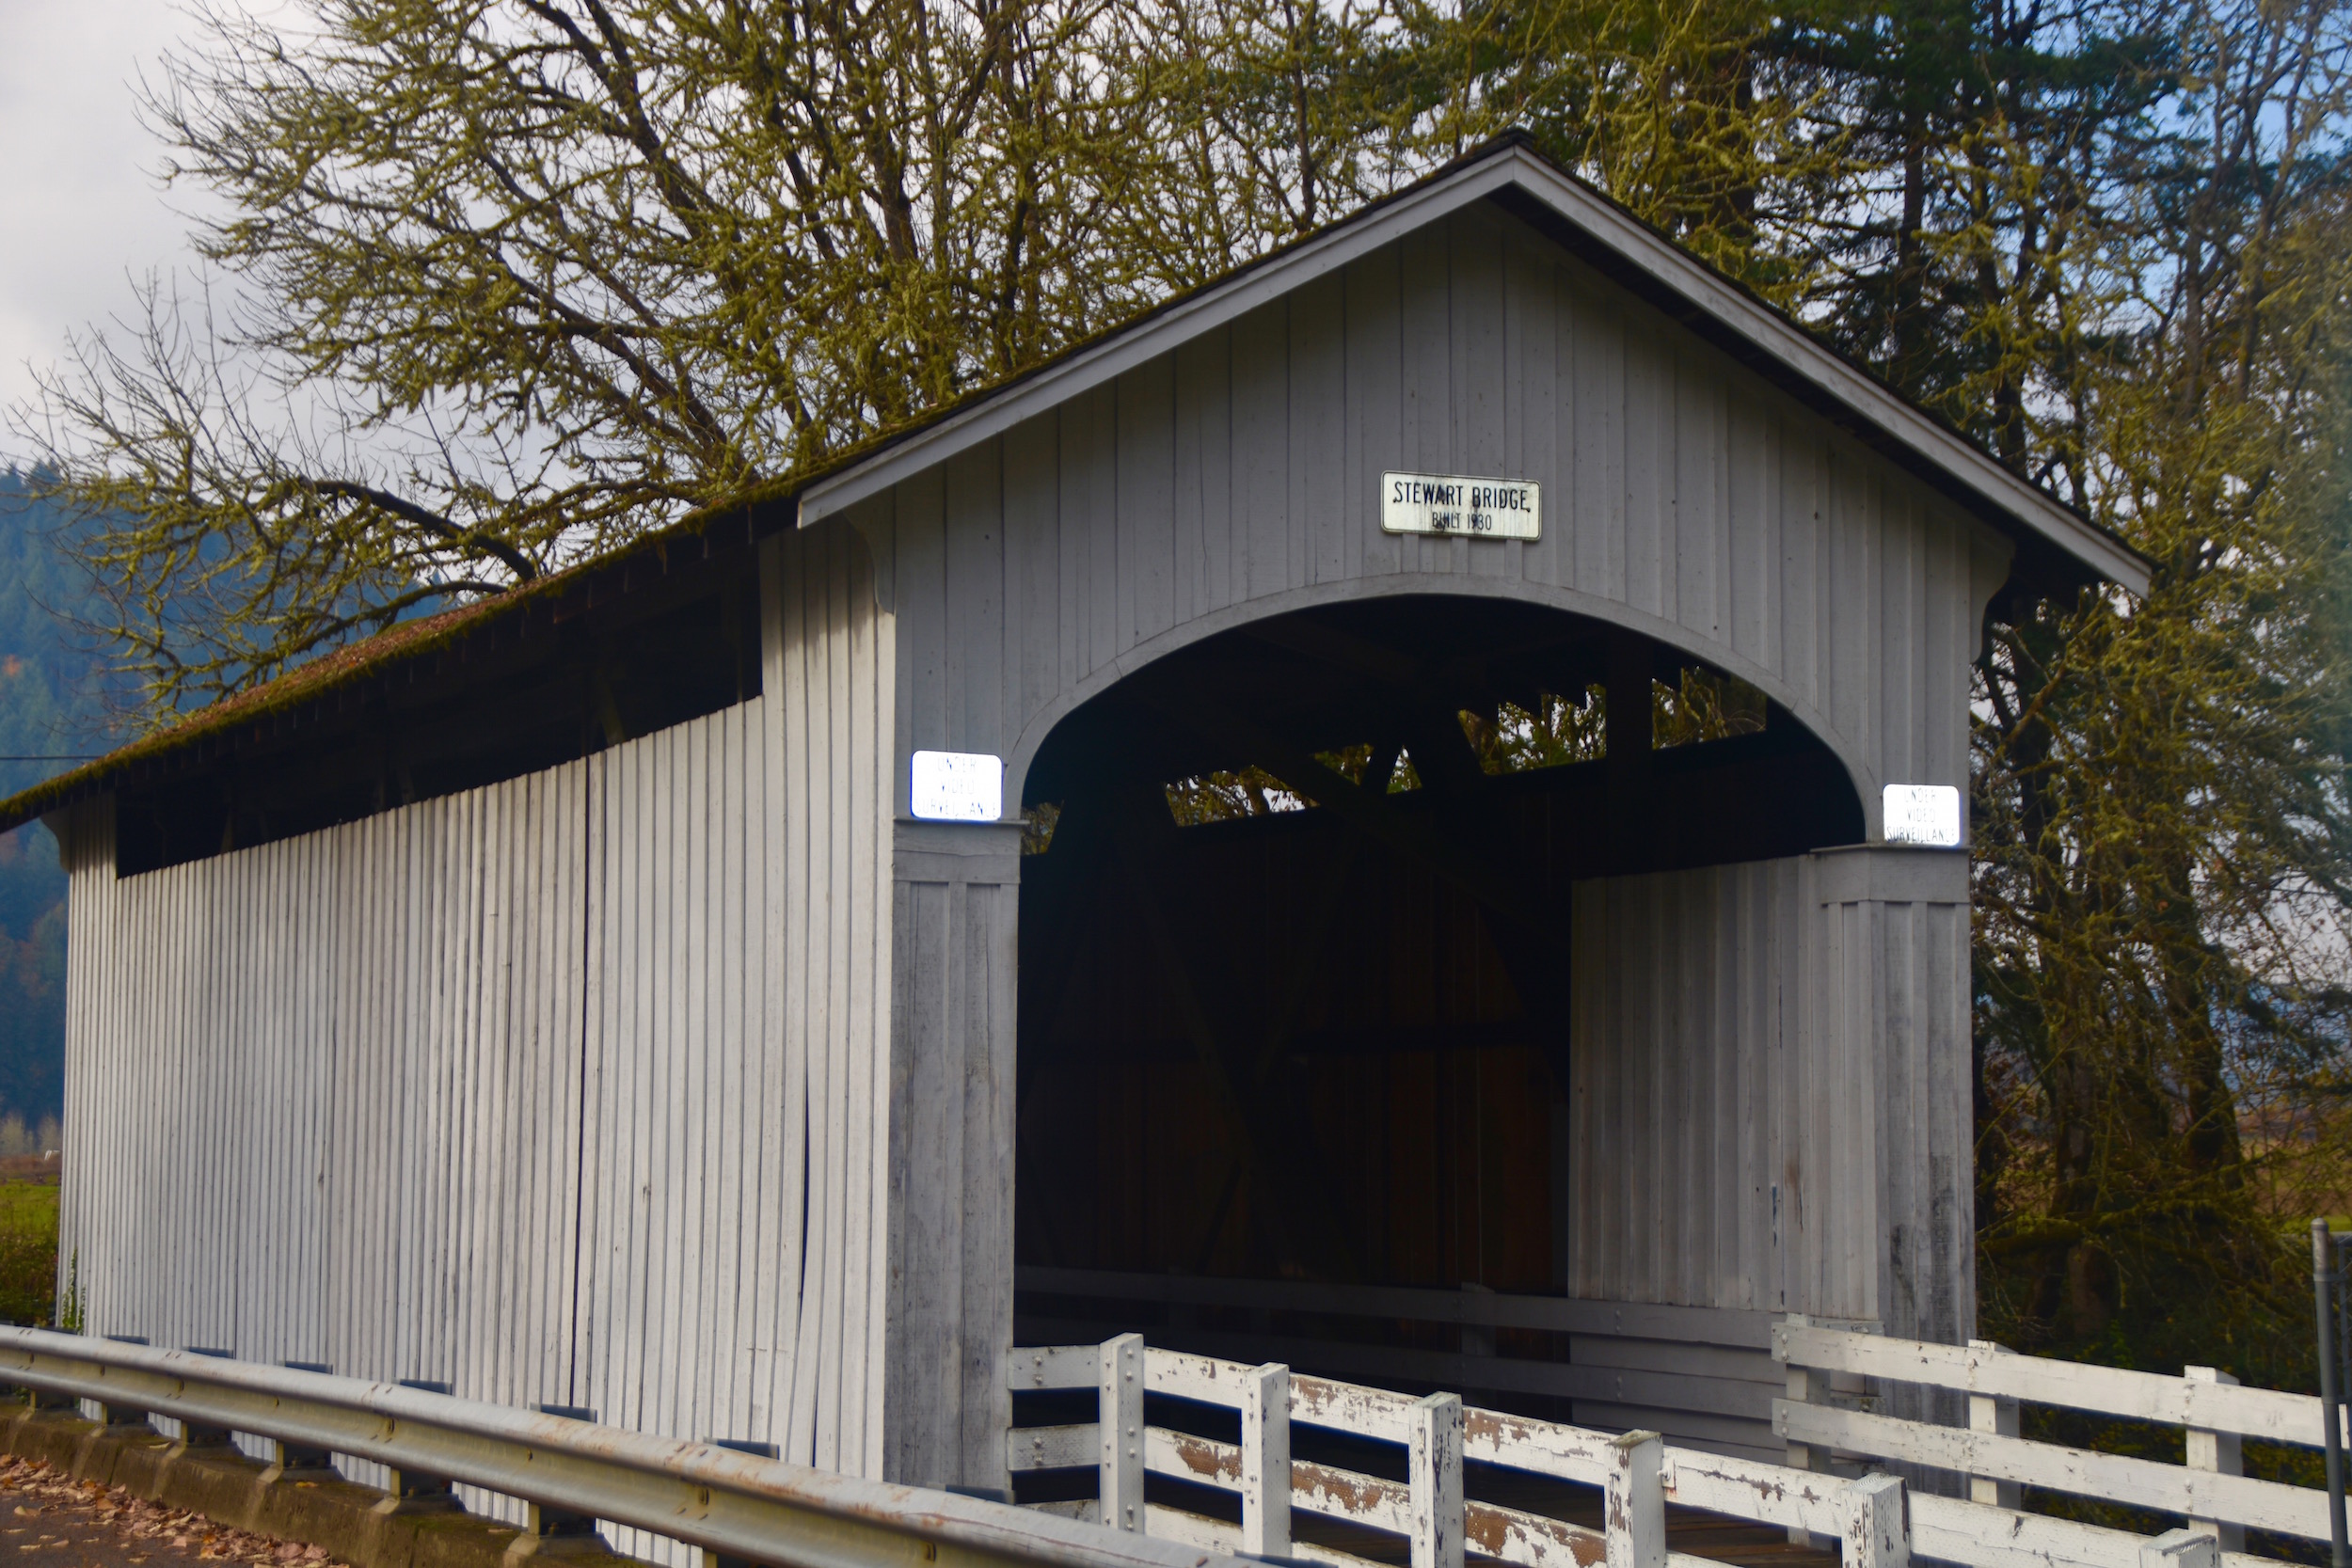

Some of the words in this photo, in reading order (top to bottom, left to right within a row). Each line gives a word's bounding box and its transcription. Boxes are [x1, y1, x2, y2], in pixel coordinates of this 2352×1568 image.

[1394, 481, 1463, 506] STEWART
[1472, 486, 1528, 511] BRIDGE
[1432, 512, 1461, 529] BUILT
[1467, 514, 1492, 531] 1930
[1904, 787, 1936, 803] UNDER
[1907, 807, 1935, 823] VIDEO
[1886, 826, 1955, 843] SURVEILLANCE
